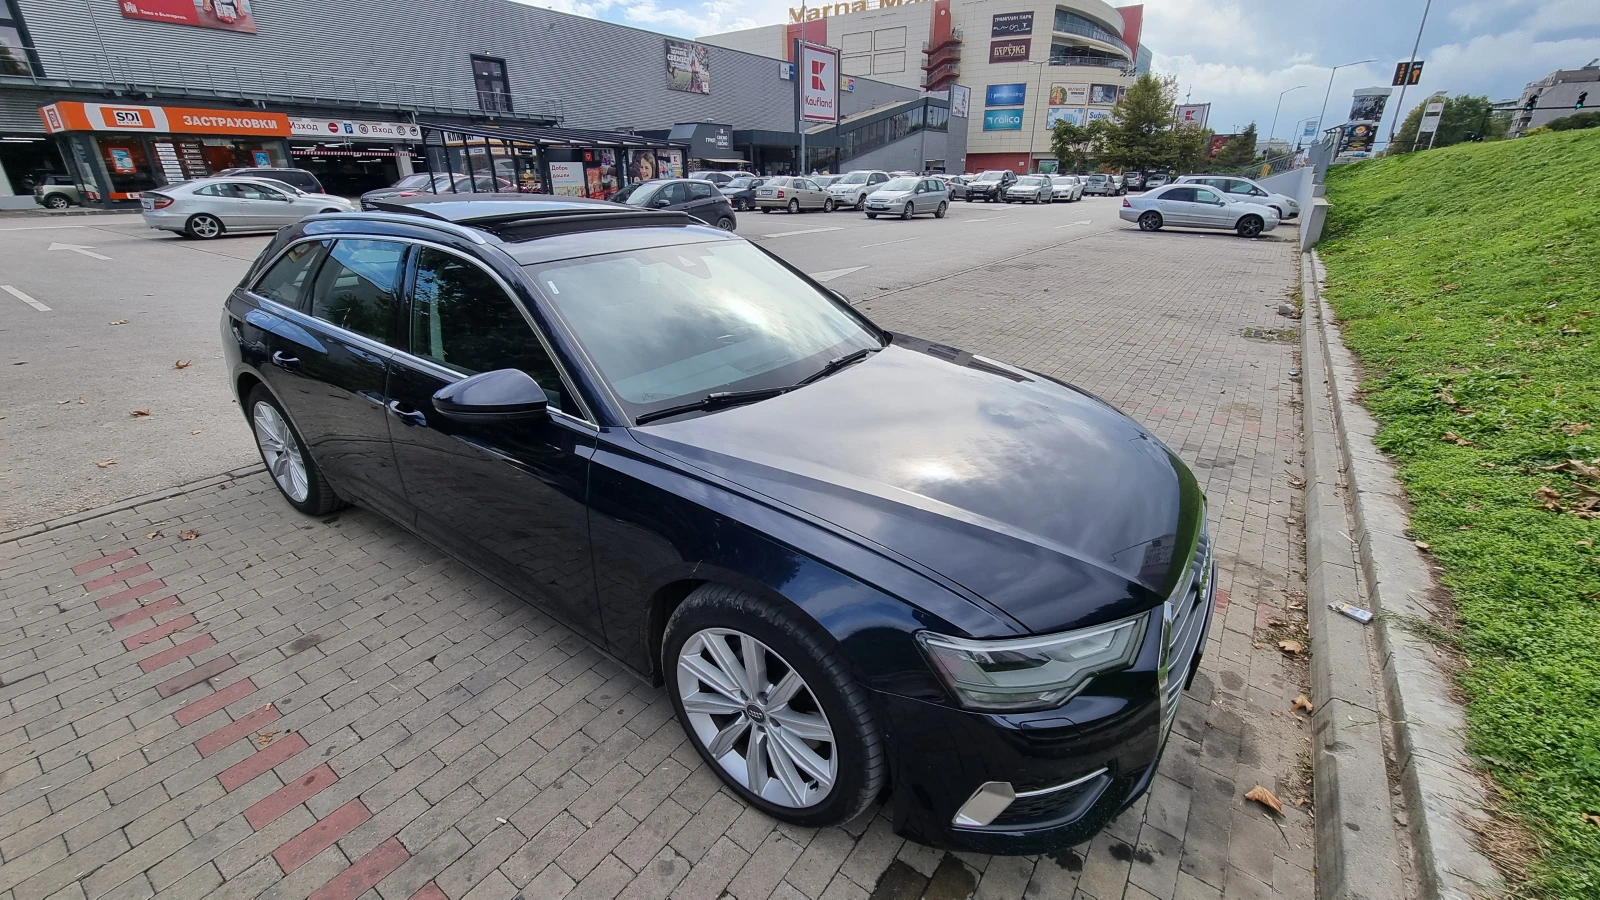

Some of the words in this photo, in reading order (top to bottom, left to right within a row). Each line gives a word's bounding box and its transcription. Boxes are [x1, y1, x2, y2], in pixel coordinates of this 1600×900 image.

[789, 0, 867, 22] Varna
[805, 96, 832, 108] Kaufland
[116, 112, 140, 122] SDI
[994, 115, 1020, 123] ralica
[183, 116, 278, 129] ЗАСТРАХОВКИ
[289, 122, 318, 131] Изход
[372, 126, 393, 134] Вход
